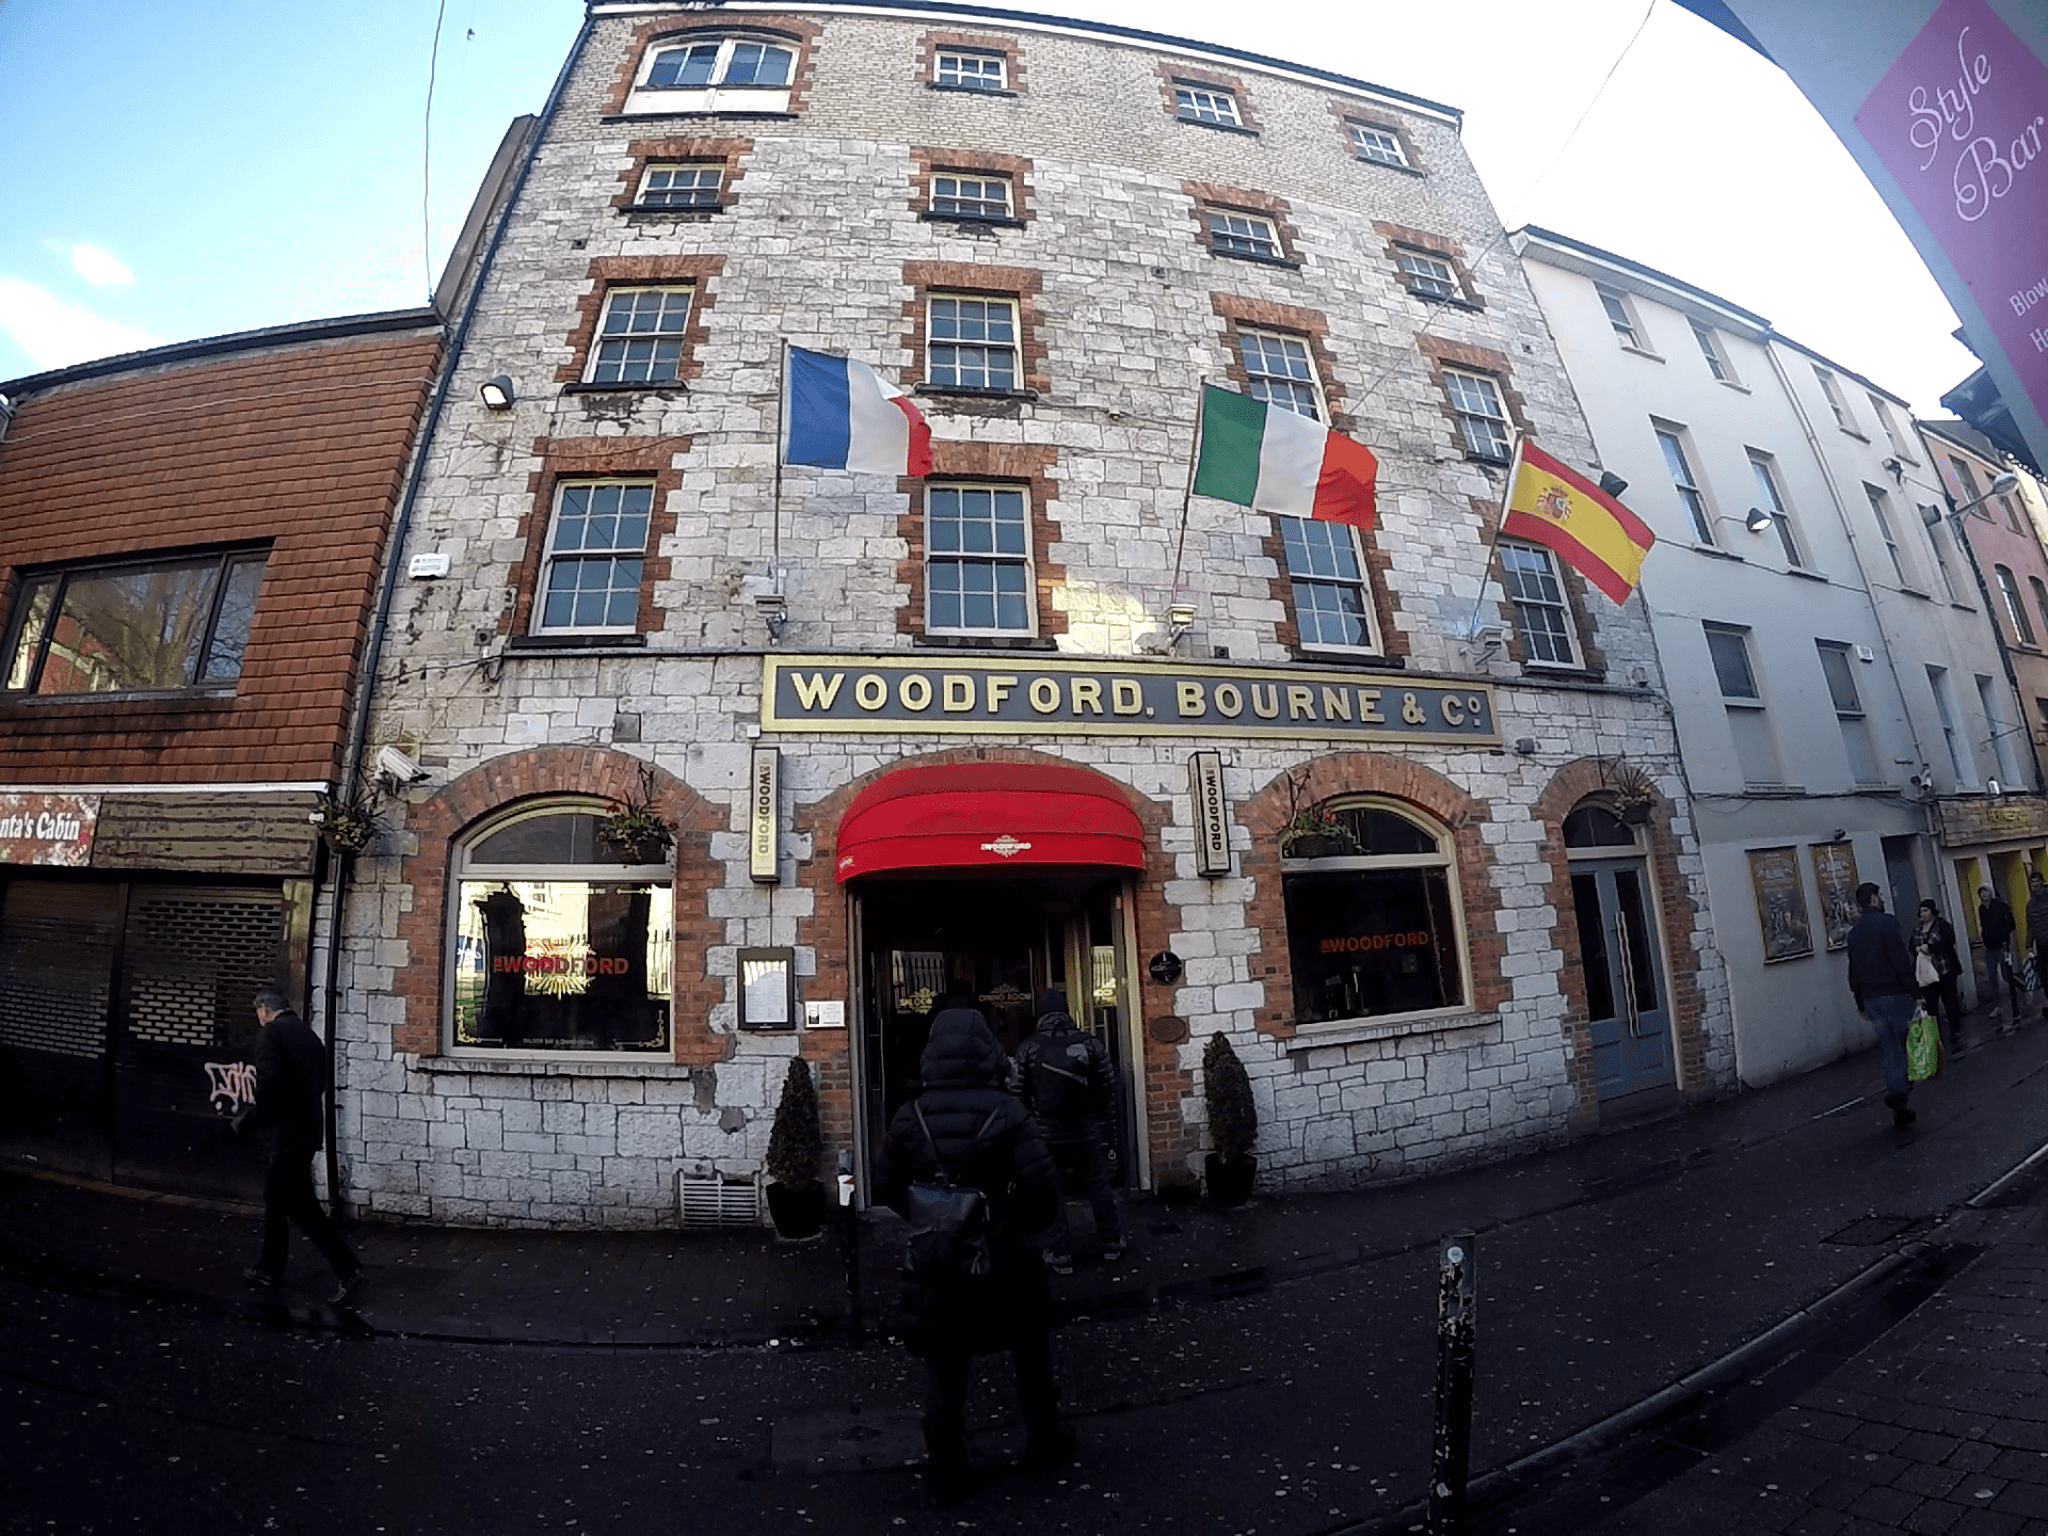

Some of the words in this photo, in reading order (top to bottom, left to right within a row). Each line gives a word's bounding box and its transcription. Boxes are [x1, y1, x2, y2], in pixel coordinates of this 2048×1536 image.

[1909, 26, 1991, 171] Style
[1953, 116, 2045, 221] Bar
[1176, 681, 1386, 724] BOURNE
[1401, 691, 1427, 724] &
[0, 811, 34, 839] nta's
[36, 811, 80, 840] Cabin
[758, 771, 771, 854] WOODFORD
[1206, 774, 1222, 851] WOODFORD
[503, 955, 629, 975] WOODFORD
[1328, 931, 1428, 953] WOODFORD
